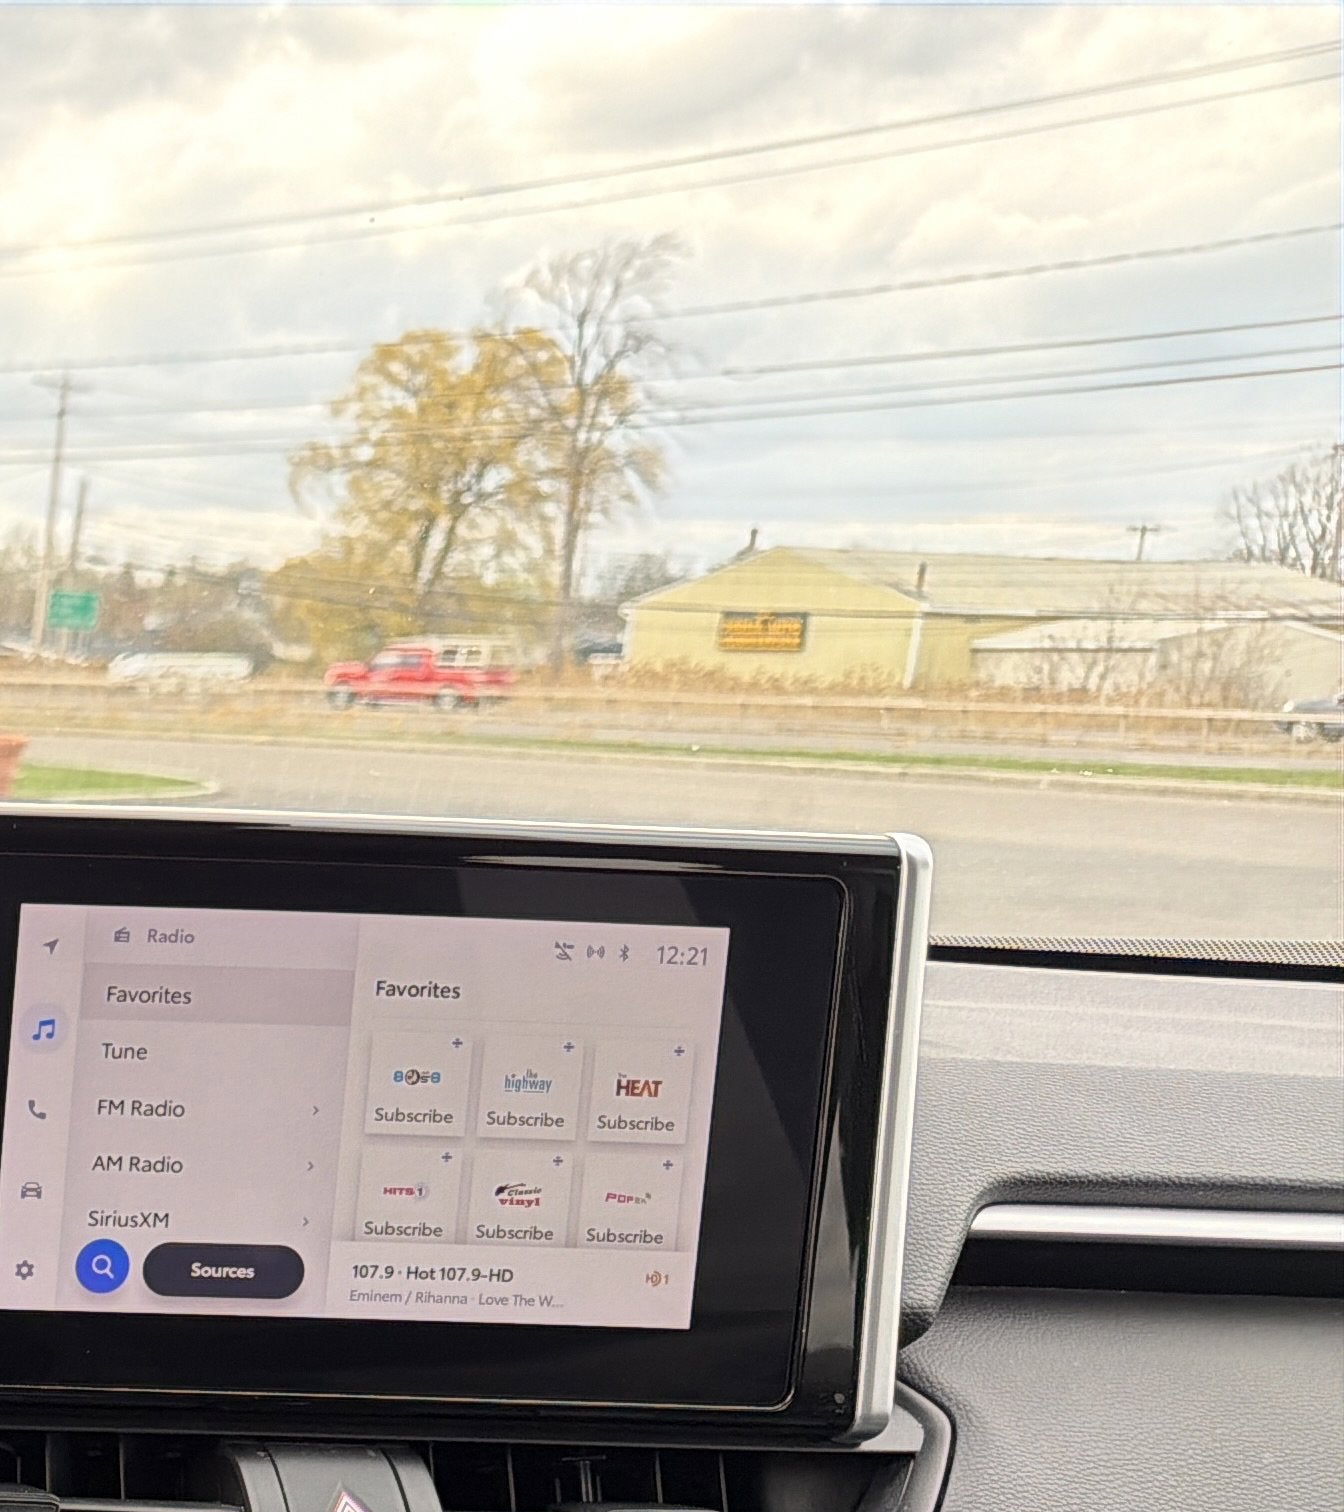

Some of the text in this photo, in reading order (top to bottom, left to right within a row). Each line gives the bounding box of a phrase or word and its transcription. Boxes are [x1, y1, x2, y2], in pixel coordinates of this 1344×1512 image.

[147, 928, 195, 944] Radio
[657, 946, 708, 966] 12:21
[105, 985, 192, 1005] Favorites
[375, 981, 461, 1000] Favorites
[101, 1043, 148, 1061] Tune
[504, 1074, 552, 1094] highway
[616, 1079, 663, 1098] HEAT
[97, 1100, 185, 1118] FM Radio
[374, 1107, 454, 1125] Subscribe
[486, 1110, 565, 1129] Subscribe
[596, 1114, 675, 1133] Subscribe
[92, 1156, 184, 1174] AM Radio
[87, 1210, 170, 1229] SiriusXM
[364, 1221, 443, 1239] Subscribe
[476, 1224, 554, 1242] Subscribe
[585, 1227, 663, 1245] Subscribe
[190, 1263, 255, 1280] Sources
[352, 1265, 514, 1283] 107.9 Hot 107.9-HD
[349, 1289, 402, 1303] Eminem
[416, 1291, 468, 1306] Rihanna
[478, 1293, 509, 1307] Love
[513, 1294, 535, 1307] The
